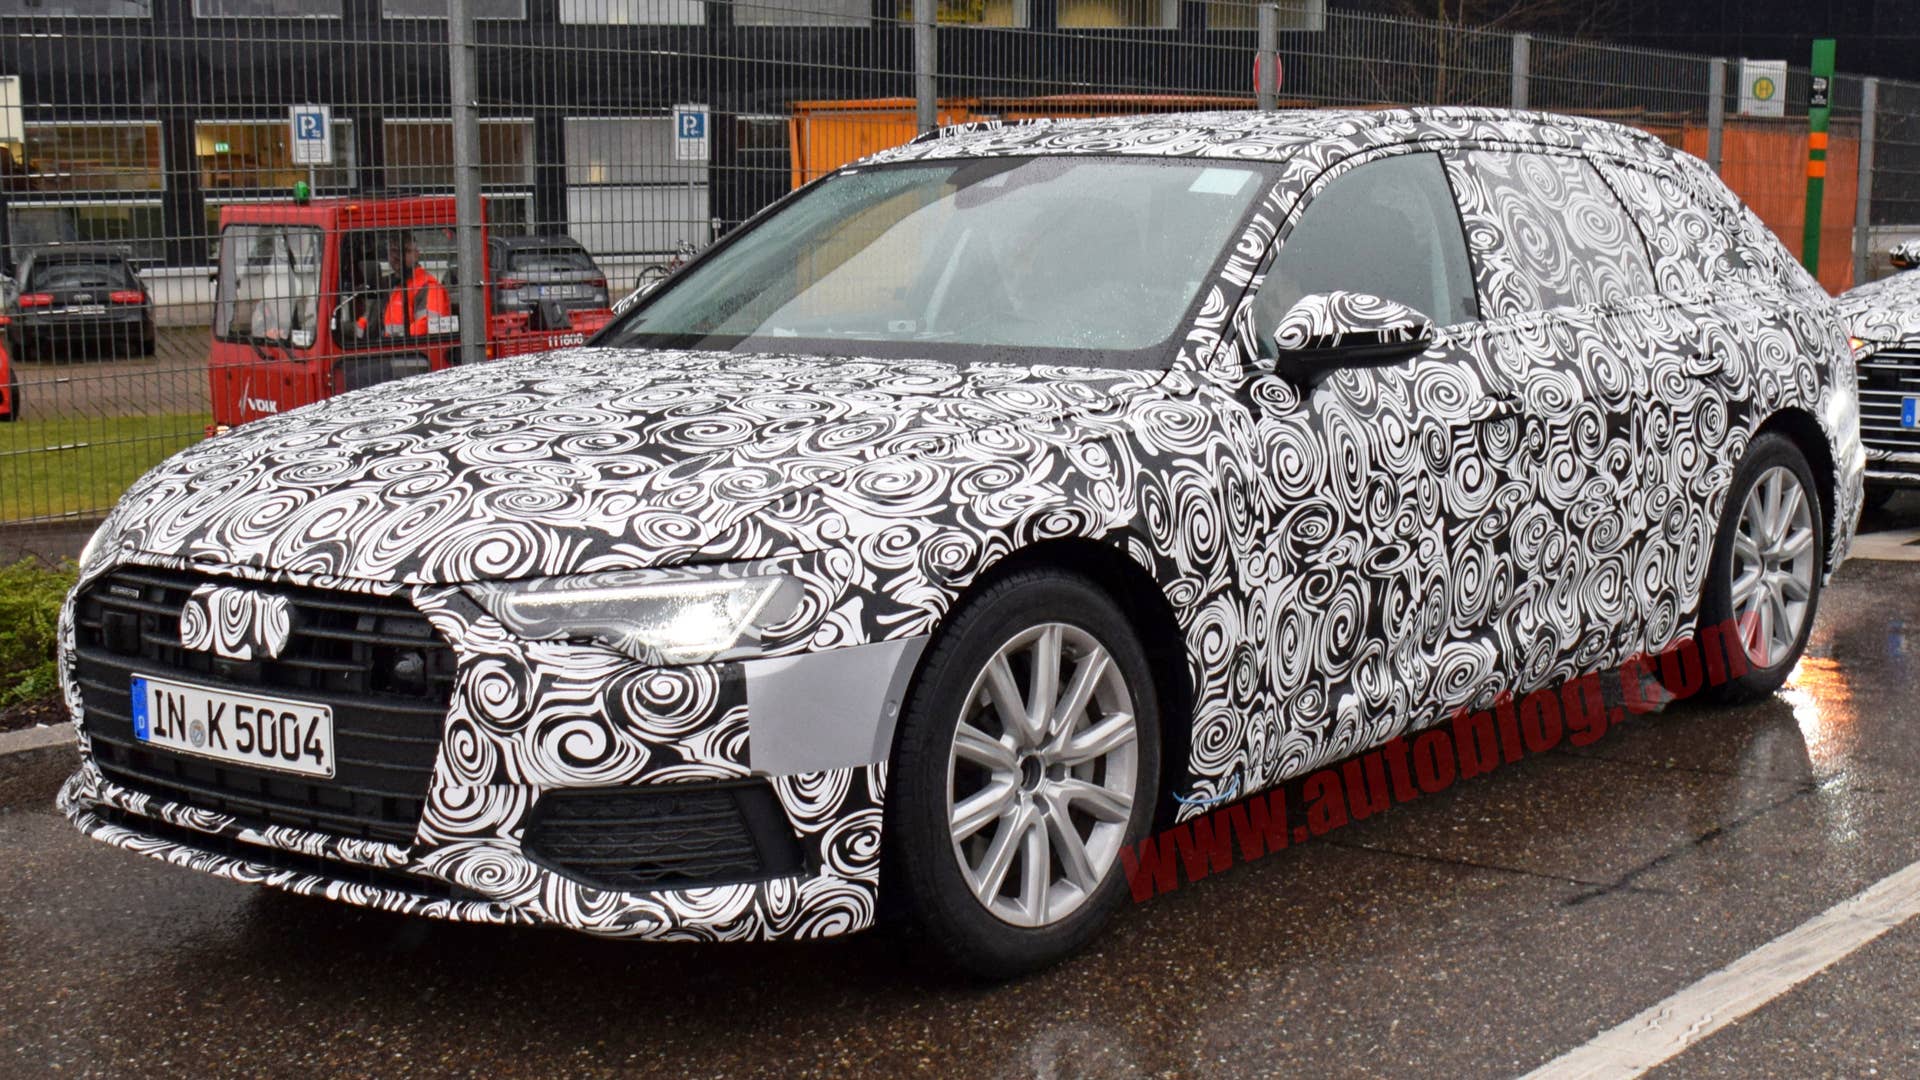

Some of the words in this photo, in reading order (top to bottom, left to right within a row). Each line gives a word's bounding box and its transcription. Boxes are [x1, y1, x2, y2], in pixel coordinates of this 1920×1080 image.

[301, 115, 316, 137] P
[683, 115, 697, 137] P
[154, 689, 186, 742] IN
[235, 704, 324, 765] 5004
